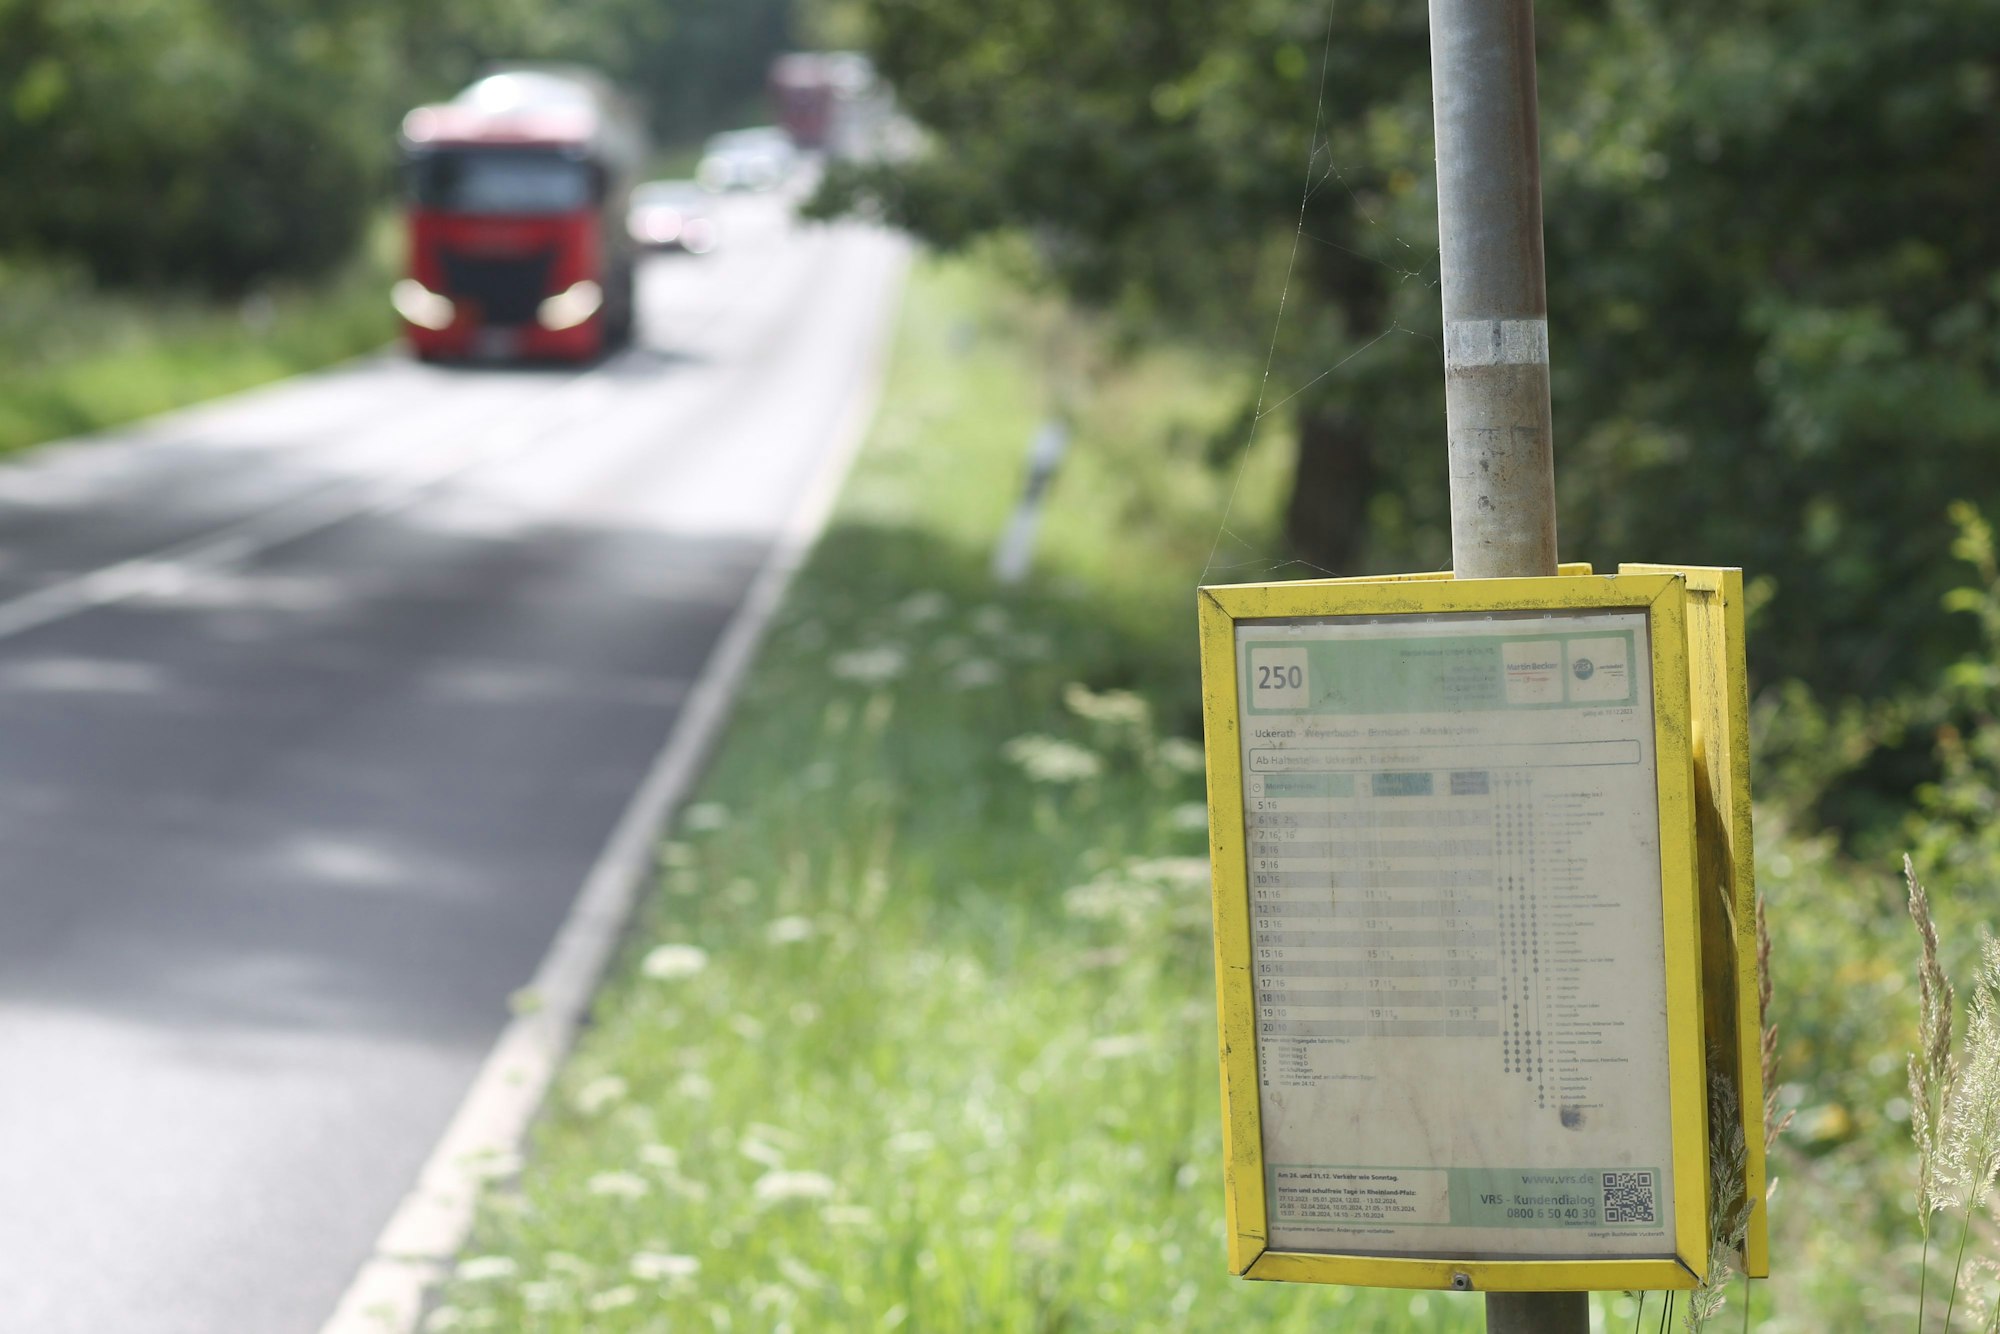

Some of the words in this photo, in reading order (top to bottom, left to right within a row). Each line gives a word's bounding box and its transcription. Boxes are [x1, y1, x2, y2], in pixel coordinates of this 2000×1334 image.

[1506, 662, 1532, 672] Martin
[1532, 661, 1558, 671] Becker
[1573, 663, 1589, 672] VRS
[1258, 665, 1304, 690] 250
[1255, 729, 1296, 738] Uckerath
[1256, 756, 1268, 765] Ab
[1258, 801, 1264, 810] 5
[1259, 830, 1265, 839] 7
[1269, 861, 1279, 869] 16
[1258, 891, 1267, 899] 11
[1271, 891, 1280, 899] 16
[1259, 920, 1269, 928] 13
[1260, 950, 1270, 958] 15
[1274, 950, 1283, 958] 16
[1368, 950, 1378, 958] 15
[1261, 964, 1271, 972] 16
[1262, 994, 1272, 1002] 18
[1370, 1009, 1381, 1017] 19
[1264, 1023, 1274, 1032] 20
[1522, 1174, 1594, 1184] www.vrs.de
[1480, 1194, 1503, 1205] VRS
[1513, 1194, 1596, 1208] Kundendialog
[1507, 1208, 1534, 1218] 0800
[1538, 1209, 1544, 1218] 6
[1548, 1209, 1561, 1218] 50
[1565, 1209, 1578, 1218] 40
[1583, 1209, 1596, 1218] 30
